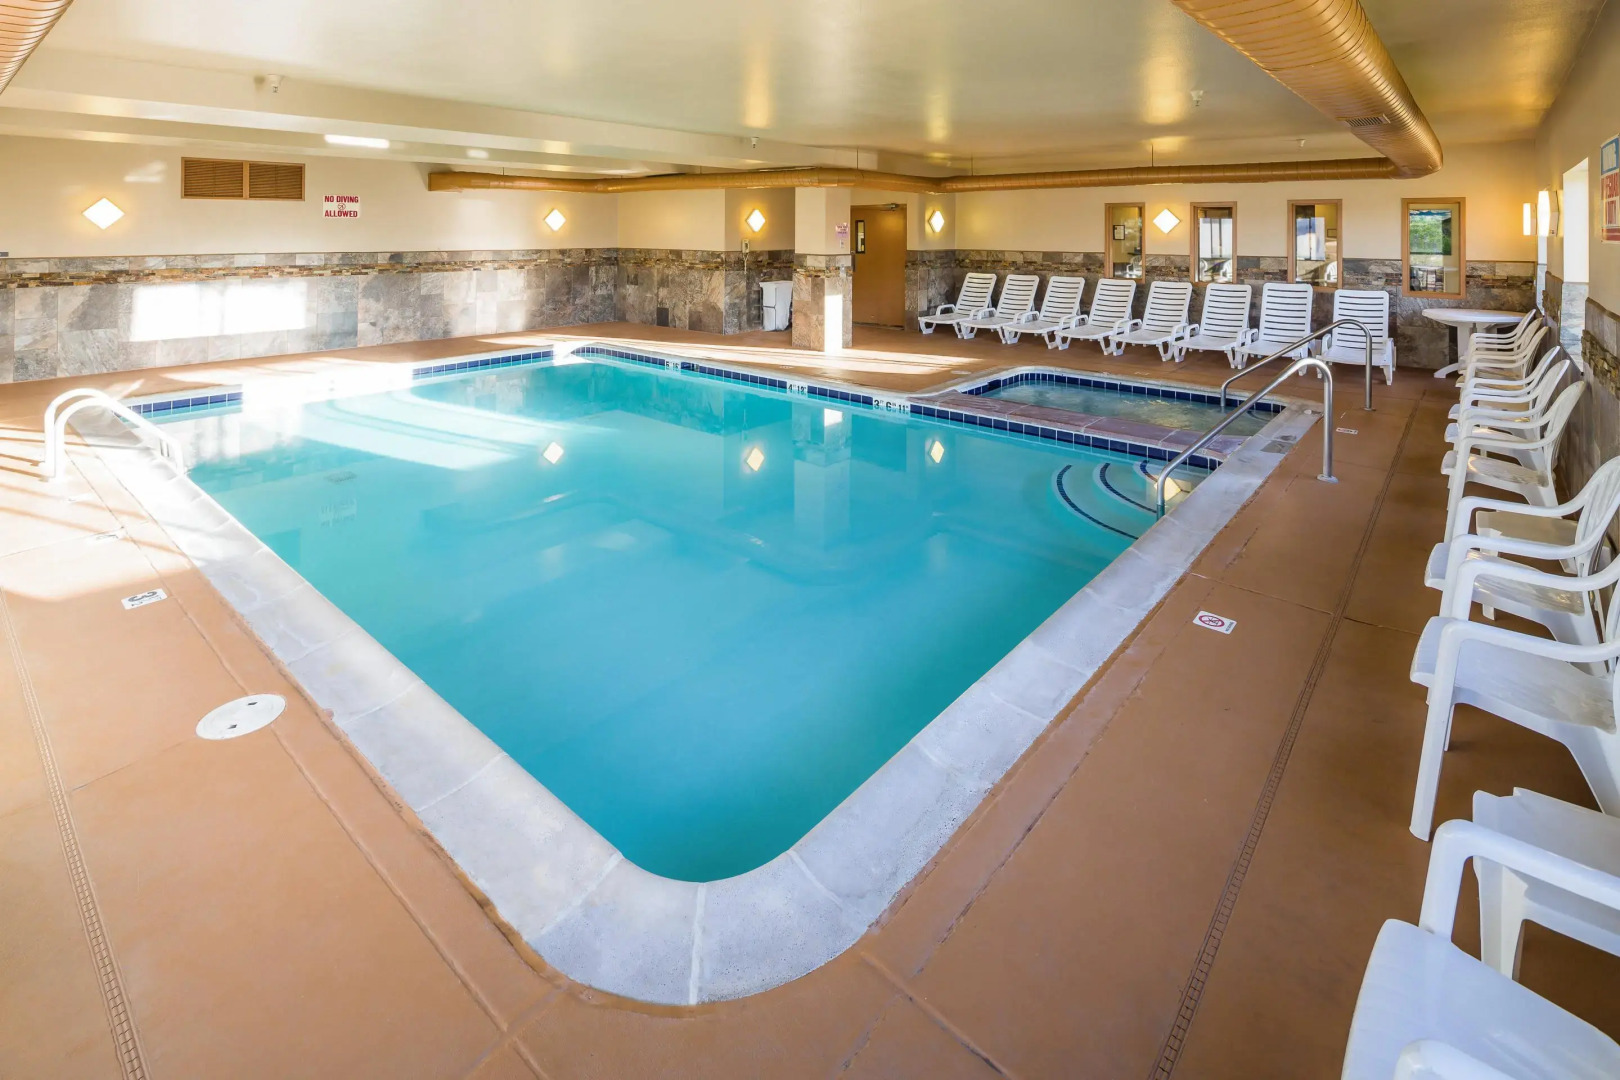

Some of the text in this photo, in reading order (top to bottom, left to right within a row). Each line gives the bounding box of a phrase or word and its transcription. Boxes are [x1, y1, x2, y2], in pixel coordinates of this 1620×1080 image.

[324, 195, 359, 203] NO DIVING
[324, 210, 358, 218] ALLOWED
